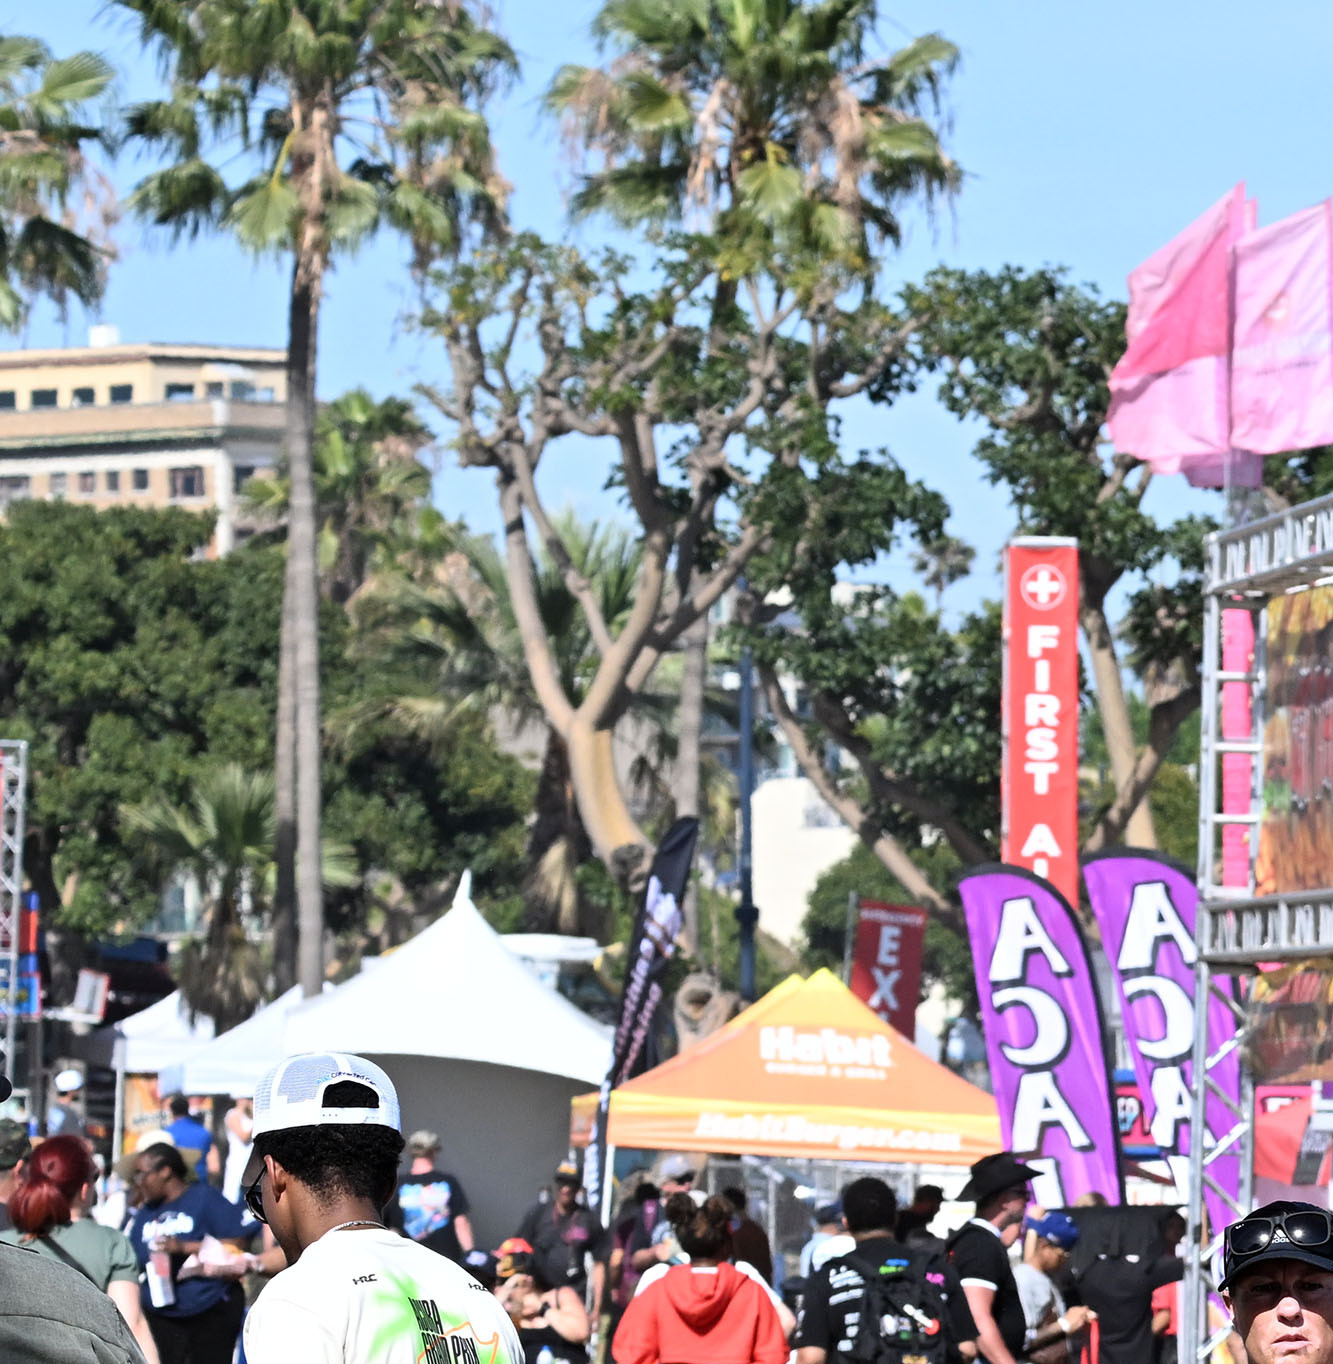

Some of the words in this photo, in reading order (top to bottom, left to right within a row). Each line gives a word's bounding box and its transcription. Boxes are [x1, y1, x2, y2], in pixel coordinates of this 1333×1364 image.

[1024, 625, 1061, 795] FIRST
[1021, 823, 1062, 880] AI
[760, 1026, 893, 1067] Habit
